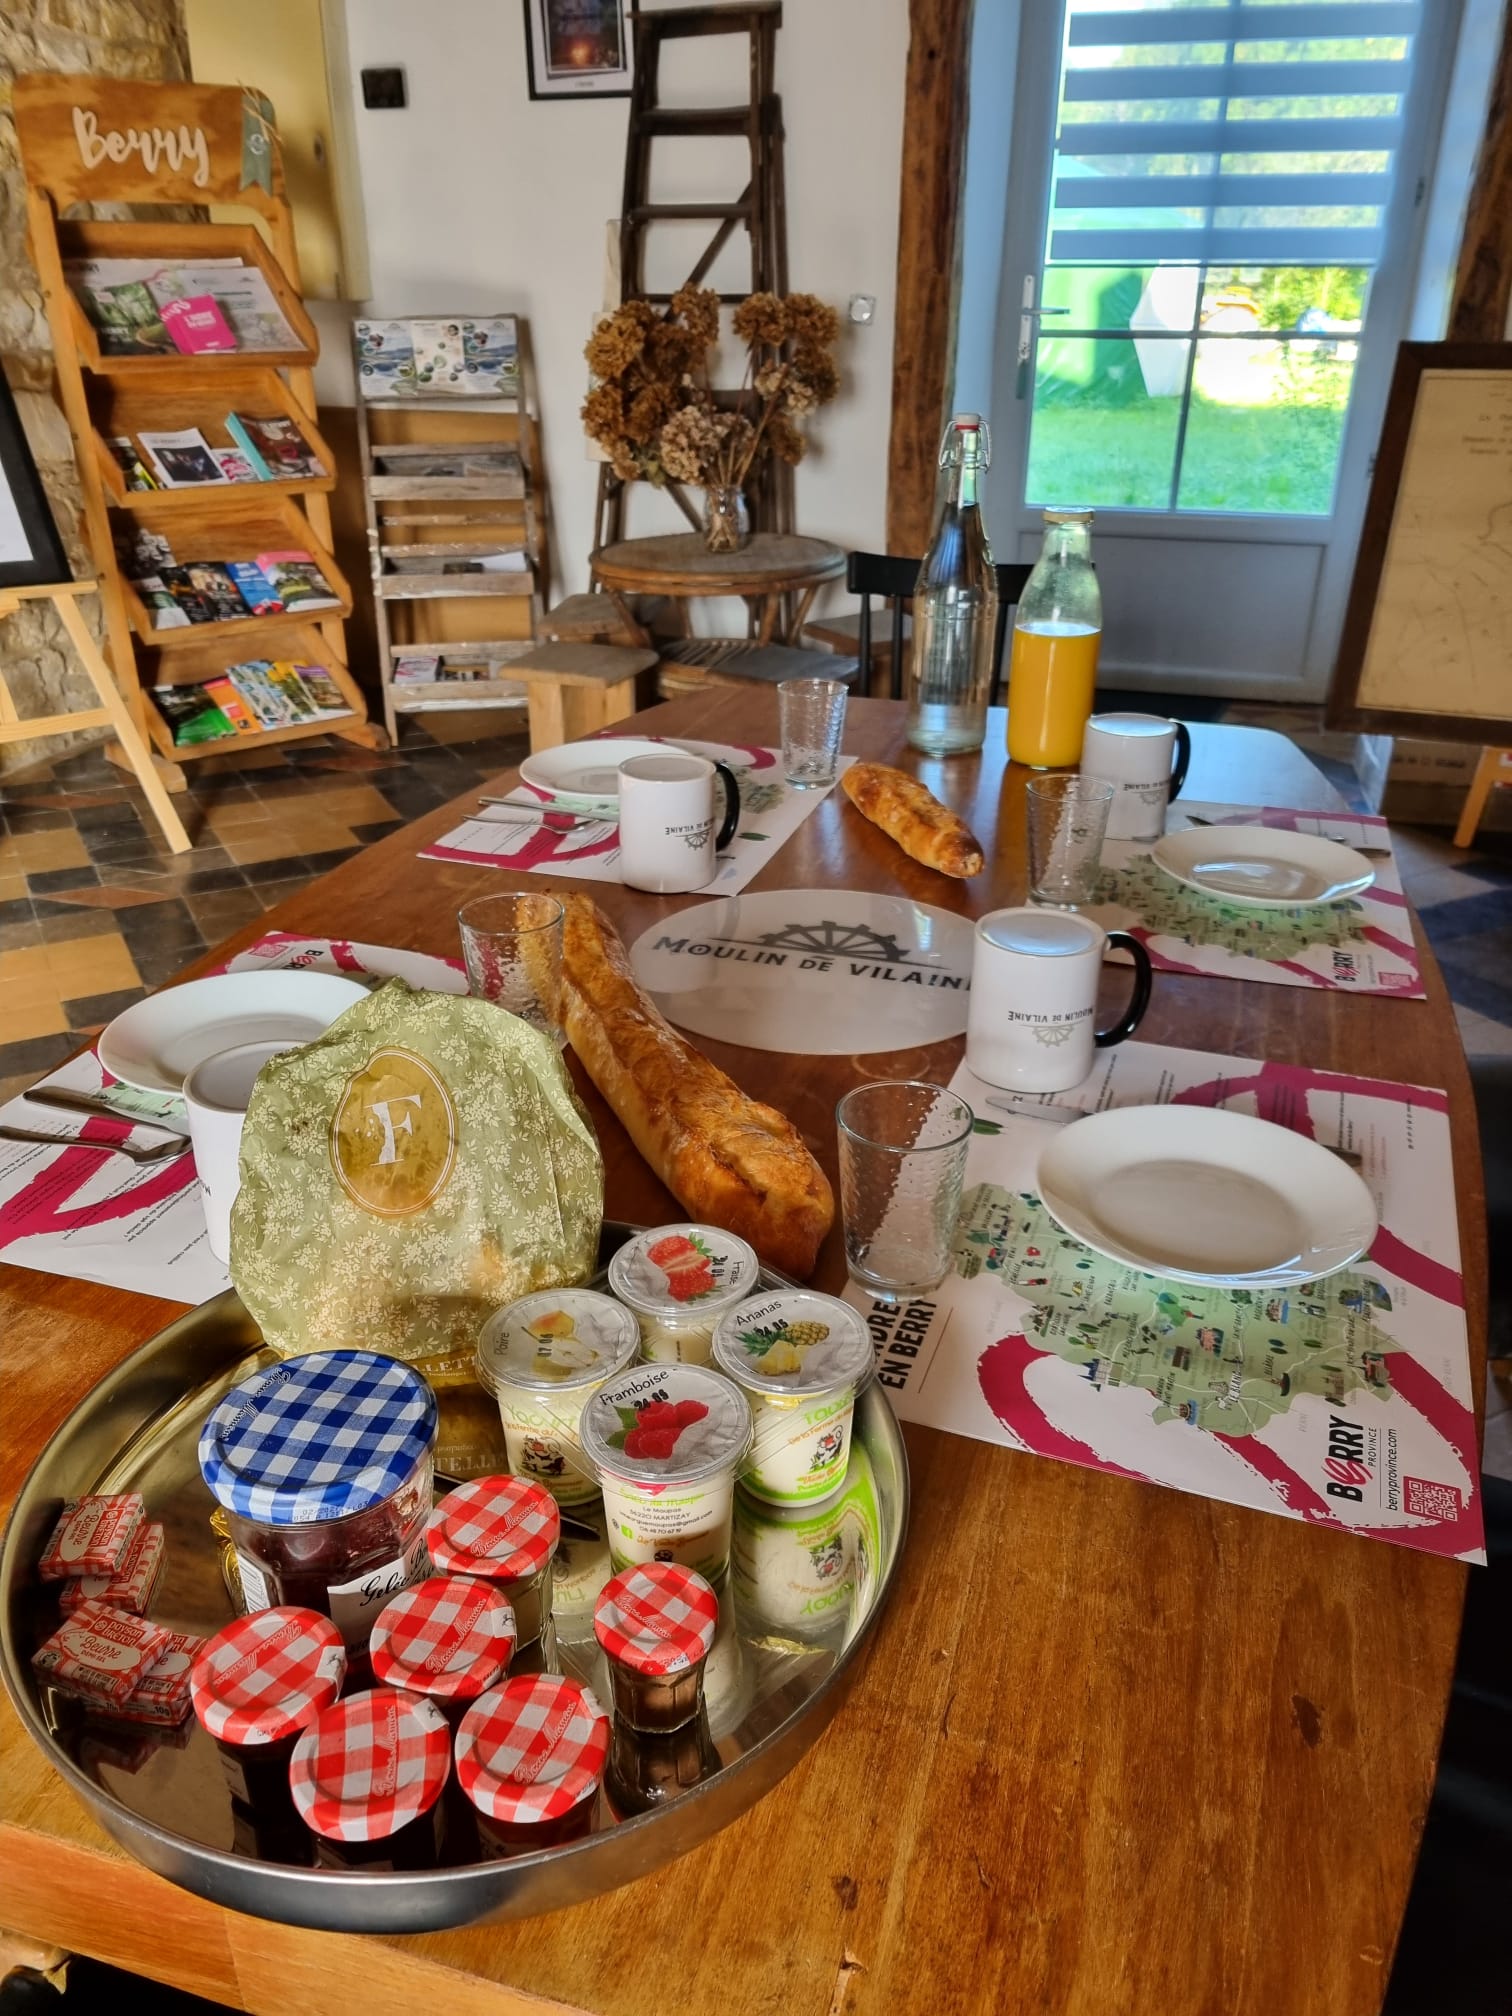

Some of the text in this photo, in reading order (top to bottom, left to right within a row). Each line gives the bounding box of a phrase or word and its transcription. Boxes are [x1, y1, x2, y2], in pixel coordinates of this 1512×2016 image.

[72, 106, 209, 187] Berry
[652, 936, 971, 991] MOULIN DE VILAIN
[1008, 1010, 1048, 1023] VILAINE
[364, 1094, 422, 1167] F
[729, 1260, 744, 1285] Fraise
[736, 1300, 782, 1326] Ananas
[494, 1332, 510, 1356] Poire
[878, 1300, 937, 1389] EN BERRY
[600, 1370, 669, 1405] Framboise
[1322, 1414, 1373, 1502] BERRY
[1368, 1428, 1377, 1467] PROVINCE
[1385, 1428, 1400, 1511] berryprovince.com
[453, 1598, 486, 1643] Maman
[80, 1635, 122, 1659] Beurre
